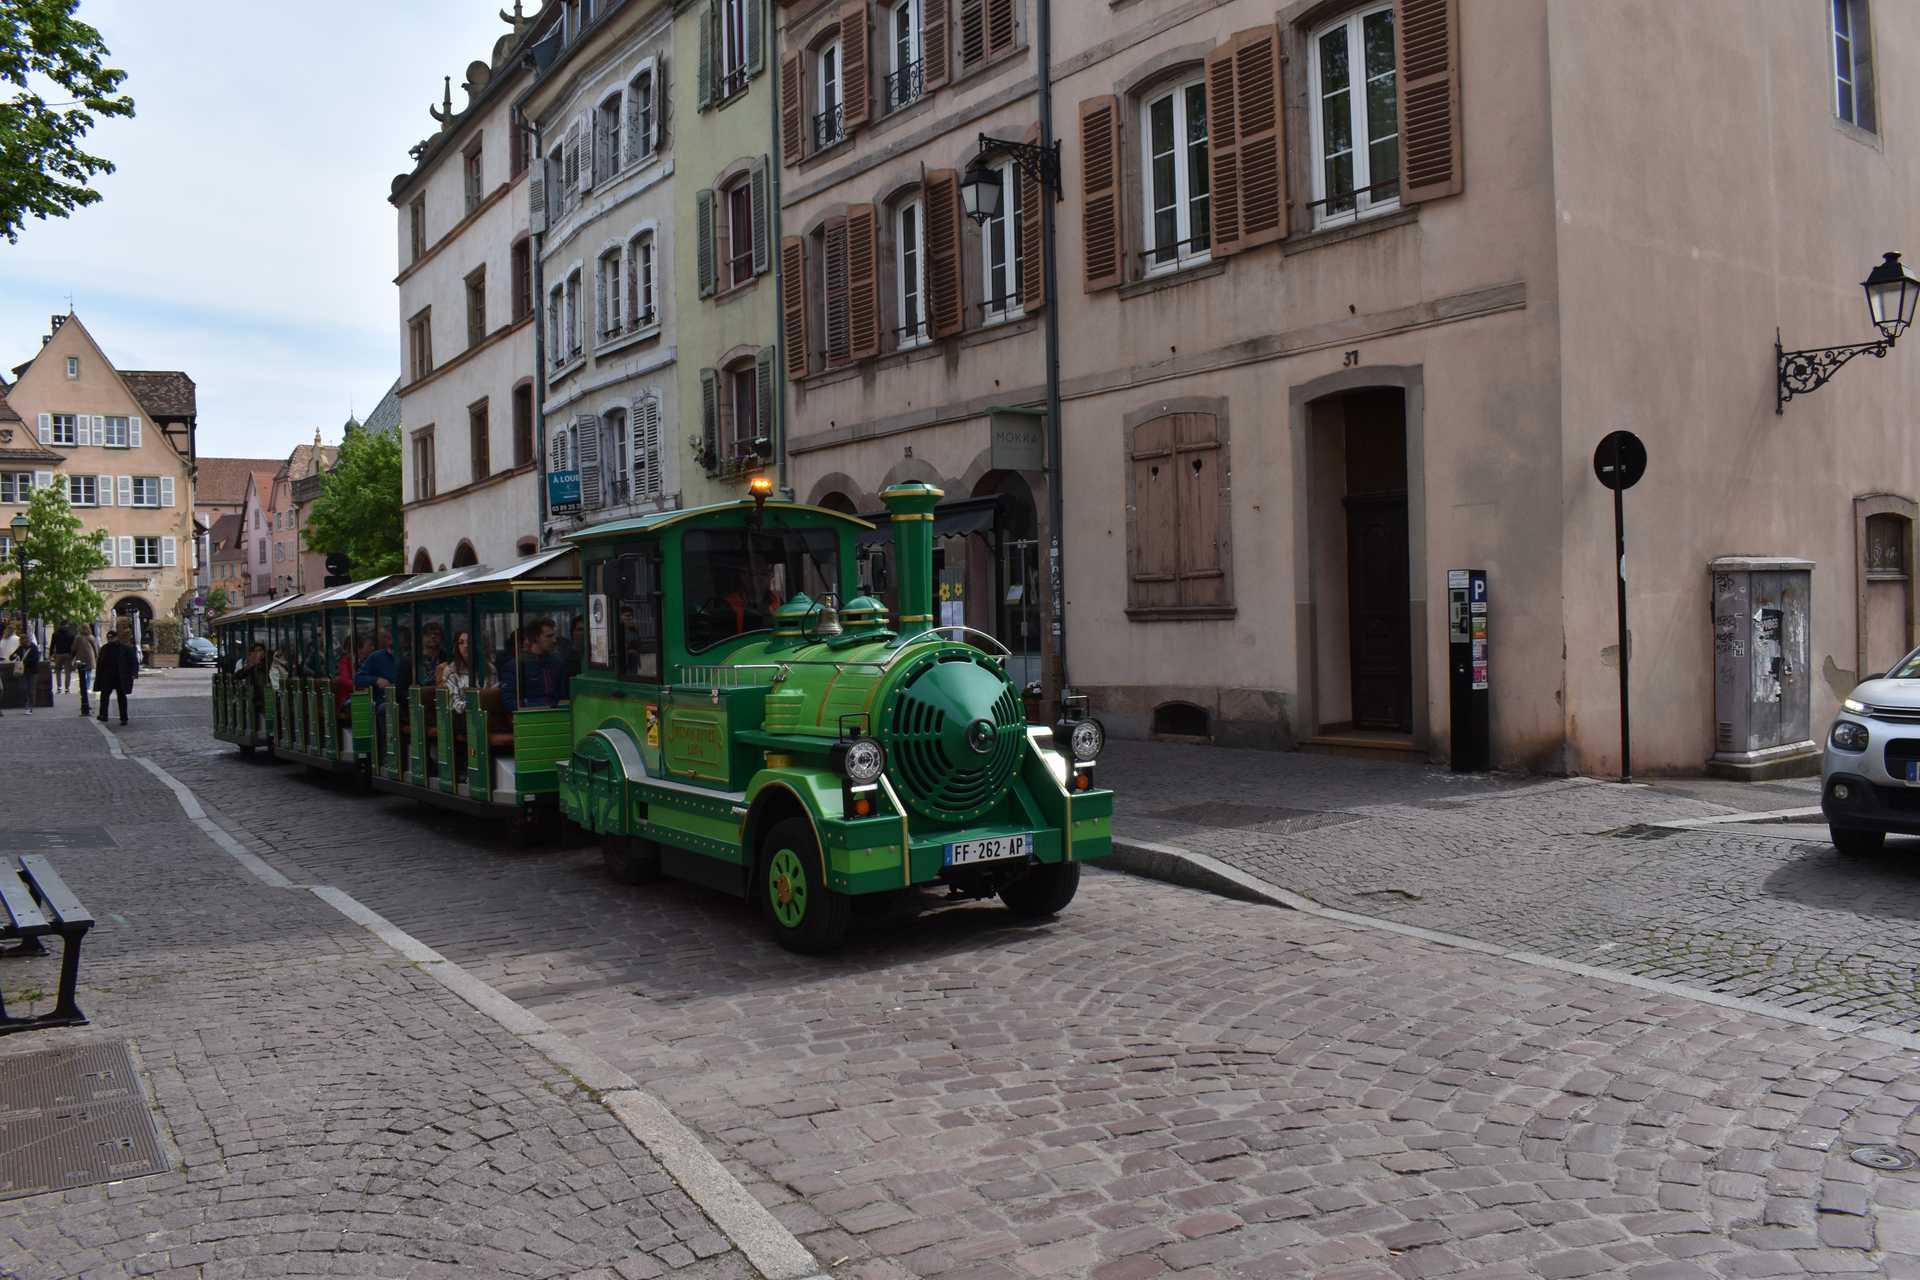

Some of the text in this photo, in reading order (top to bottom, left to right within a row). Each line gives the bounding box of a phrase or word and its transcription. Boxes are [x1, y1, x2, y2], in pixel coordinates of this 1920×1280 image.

[1343, 350, 1358, 367] 37
[996, 432, 1040, 443] MOKKA
[1474, 580, 1485, 600] P
